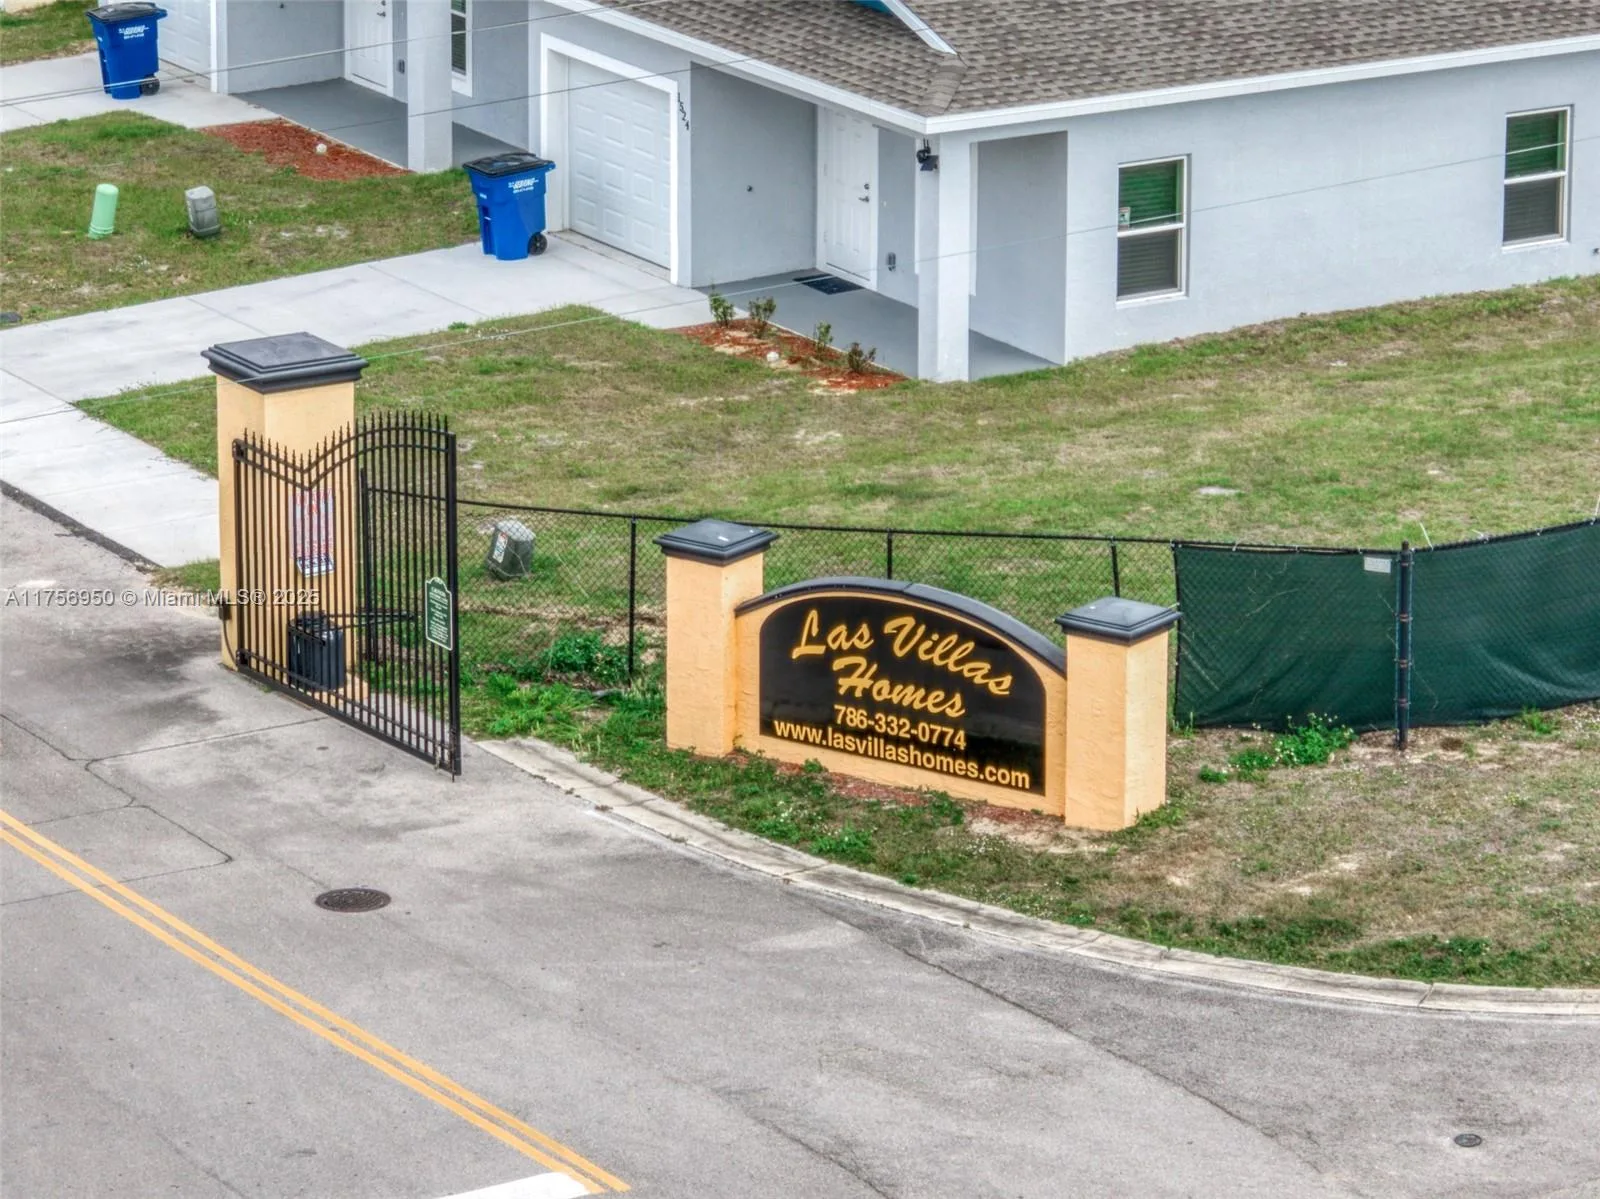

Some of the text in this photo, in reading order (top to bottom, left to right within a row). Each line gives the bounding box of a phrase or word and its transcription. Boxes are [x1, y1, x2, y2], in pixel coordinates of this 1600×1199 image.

[792, 609, 1013, 695] Las Villas
[832, 656, 966, 718] Homes
[774, 720, 1031, 790] www.lasvillashomes.com
[834, 704, 967, 750] 786-332-0774
